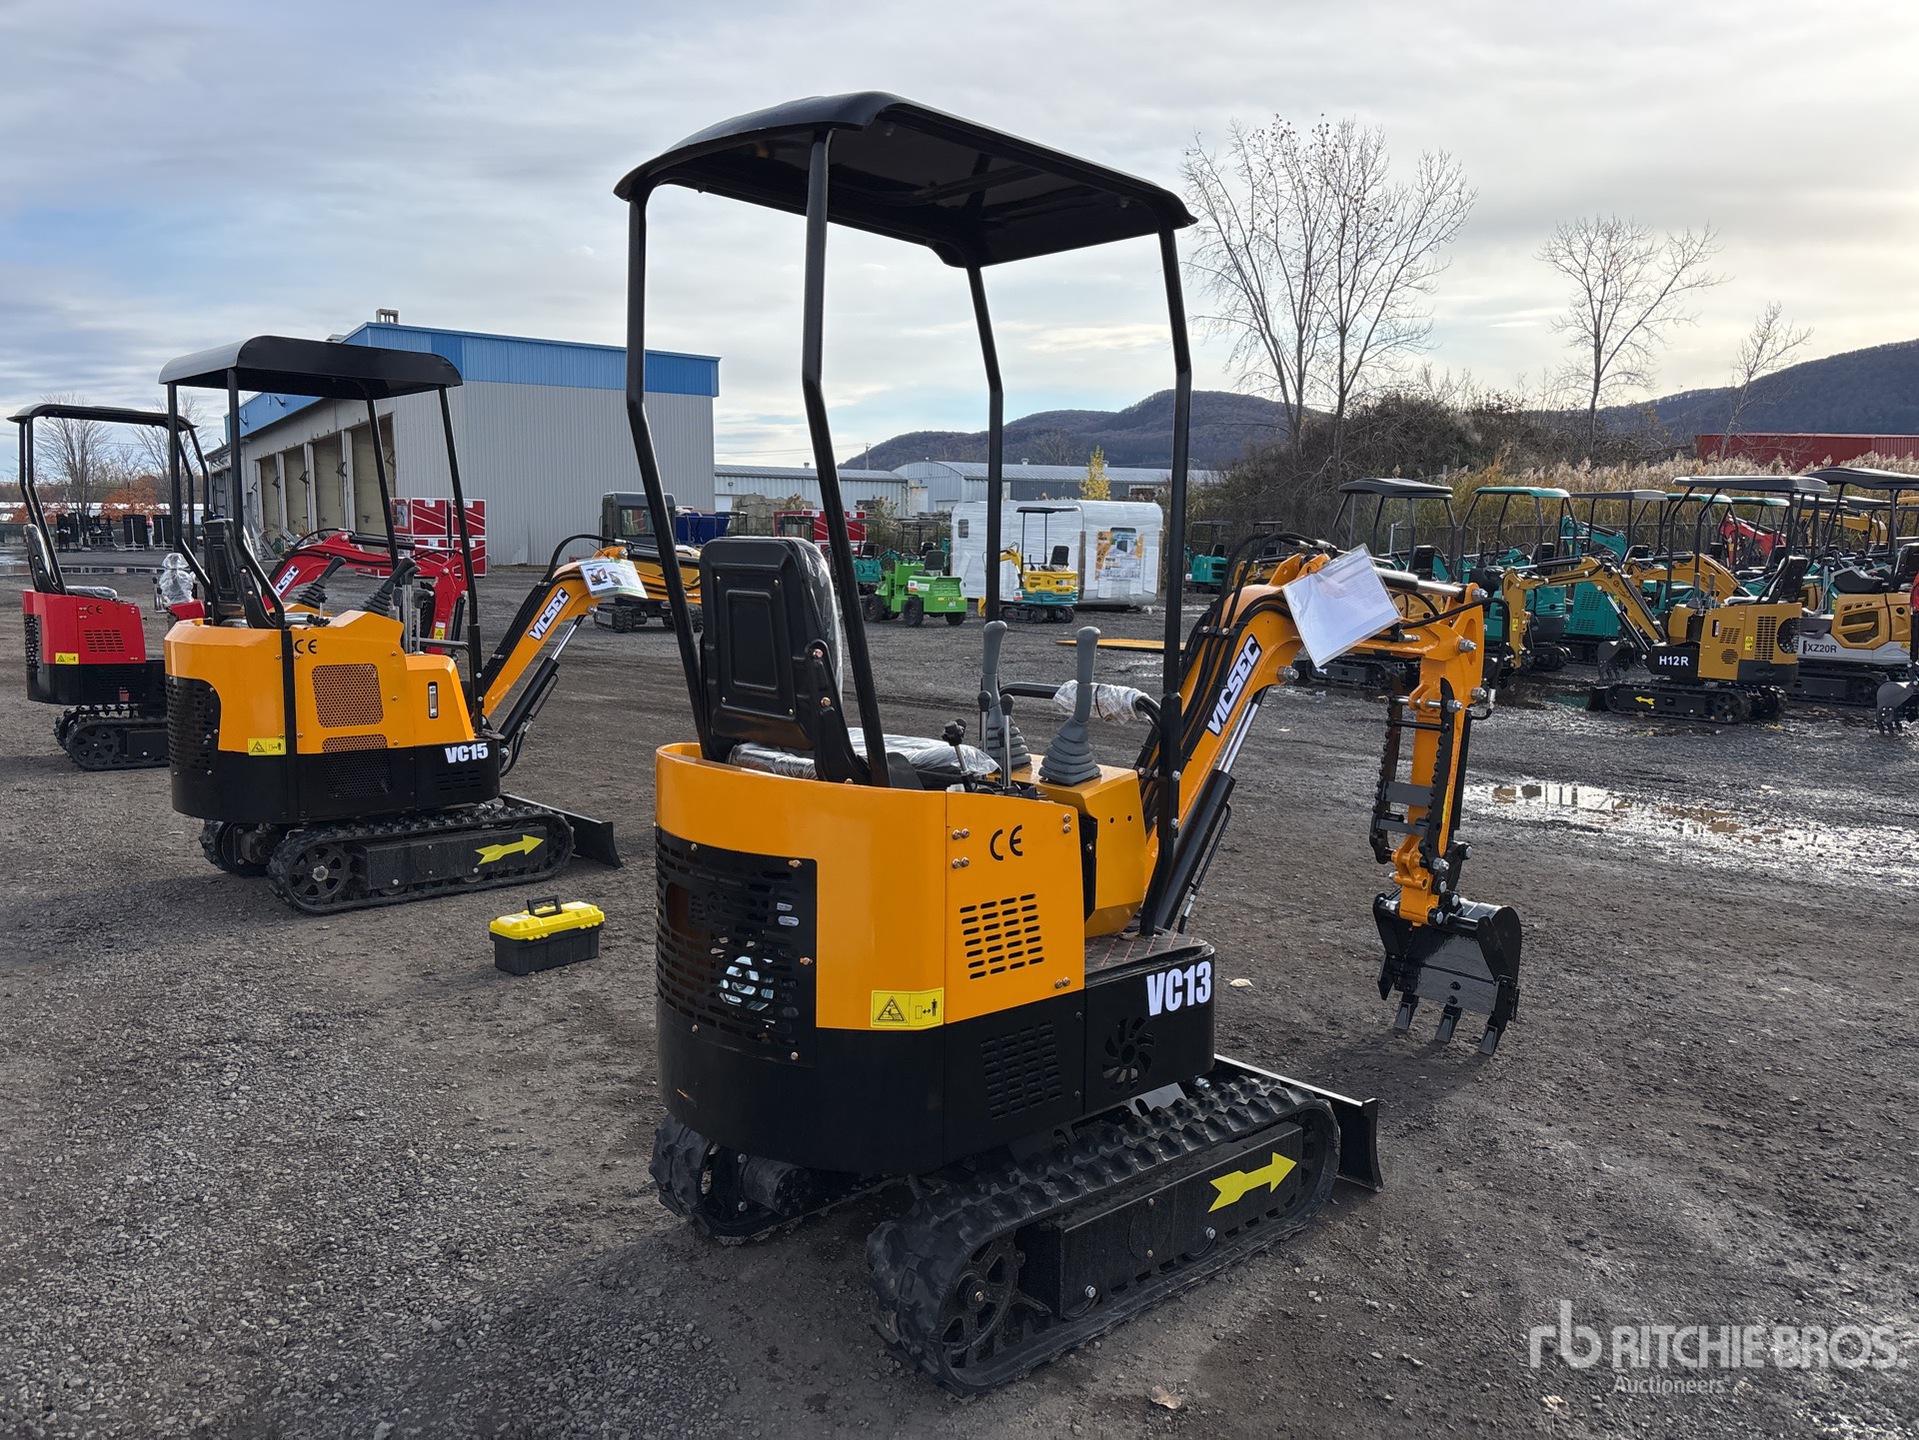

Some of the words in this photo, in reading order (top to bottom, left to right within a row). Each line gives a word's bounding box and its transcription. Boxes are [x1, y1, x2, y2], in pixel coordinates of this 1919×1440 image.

[529, 588, 570, 640] VICSEC
[295, 639, 317, 654] CE
[1659, 655, 1690, 666] H12R
[1207, 635, 1261, 736] VICSEC
[445, 743, 488, 763] VC15
[990, 825, 1023, 861] CE
[1147, 961, 1211, 1017] VC13
